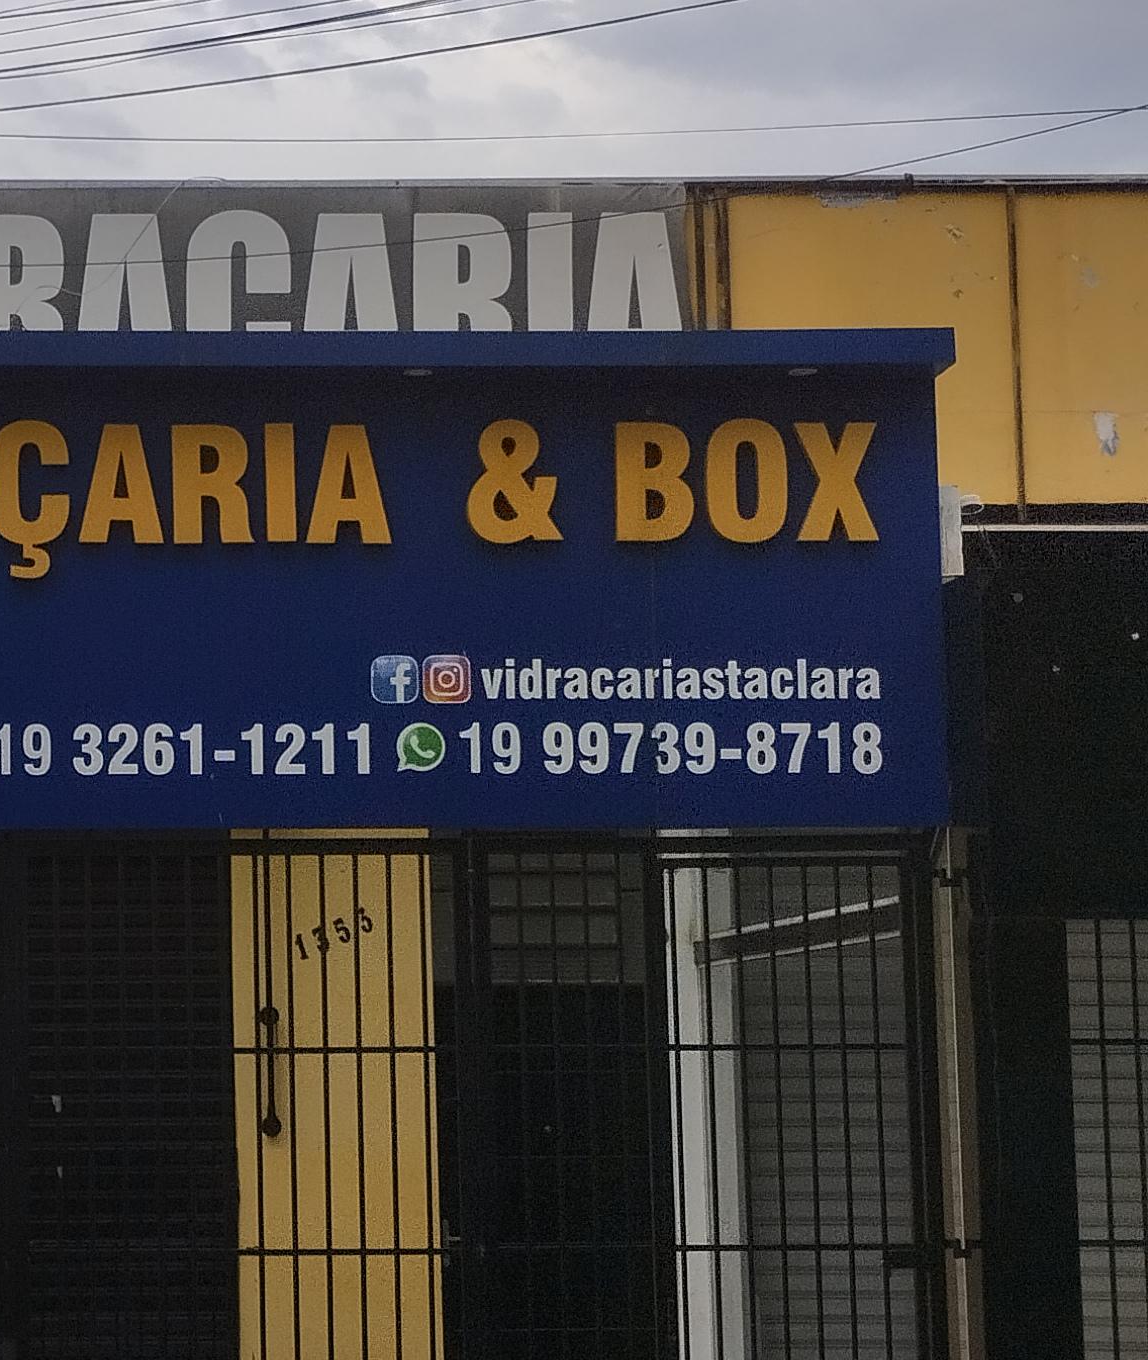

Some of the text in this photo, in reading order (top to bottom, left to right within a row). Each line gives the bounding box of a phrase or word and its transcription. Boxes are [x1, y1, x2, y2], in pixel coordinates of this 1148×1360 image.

[465, 418, 564, 545] &
[613, 417, 881, 544] BOX
[481, 658, 882, 701] vidracariastaclara
[72, 722, 371, 776] 3261-1211
[459, 721, 522, 775] 19
[542, 721, 884, 775] 99739-8718
